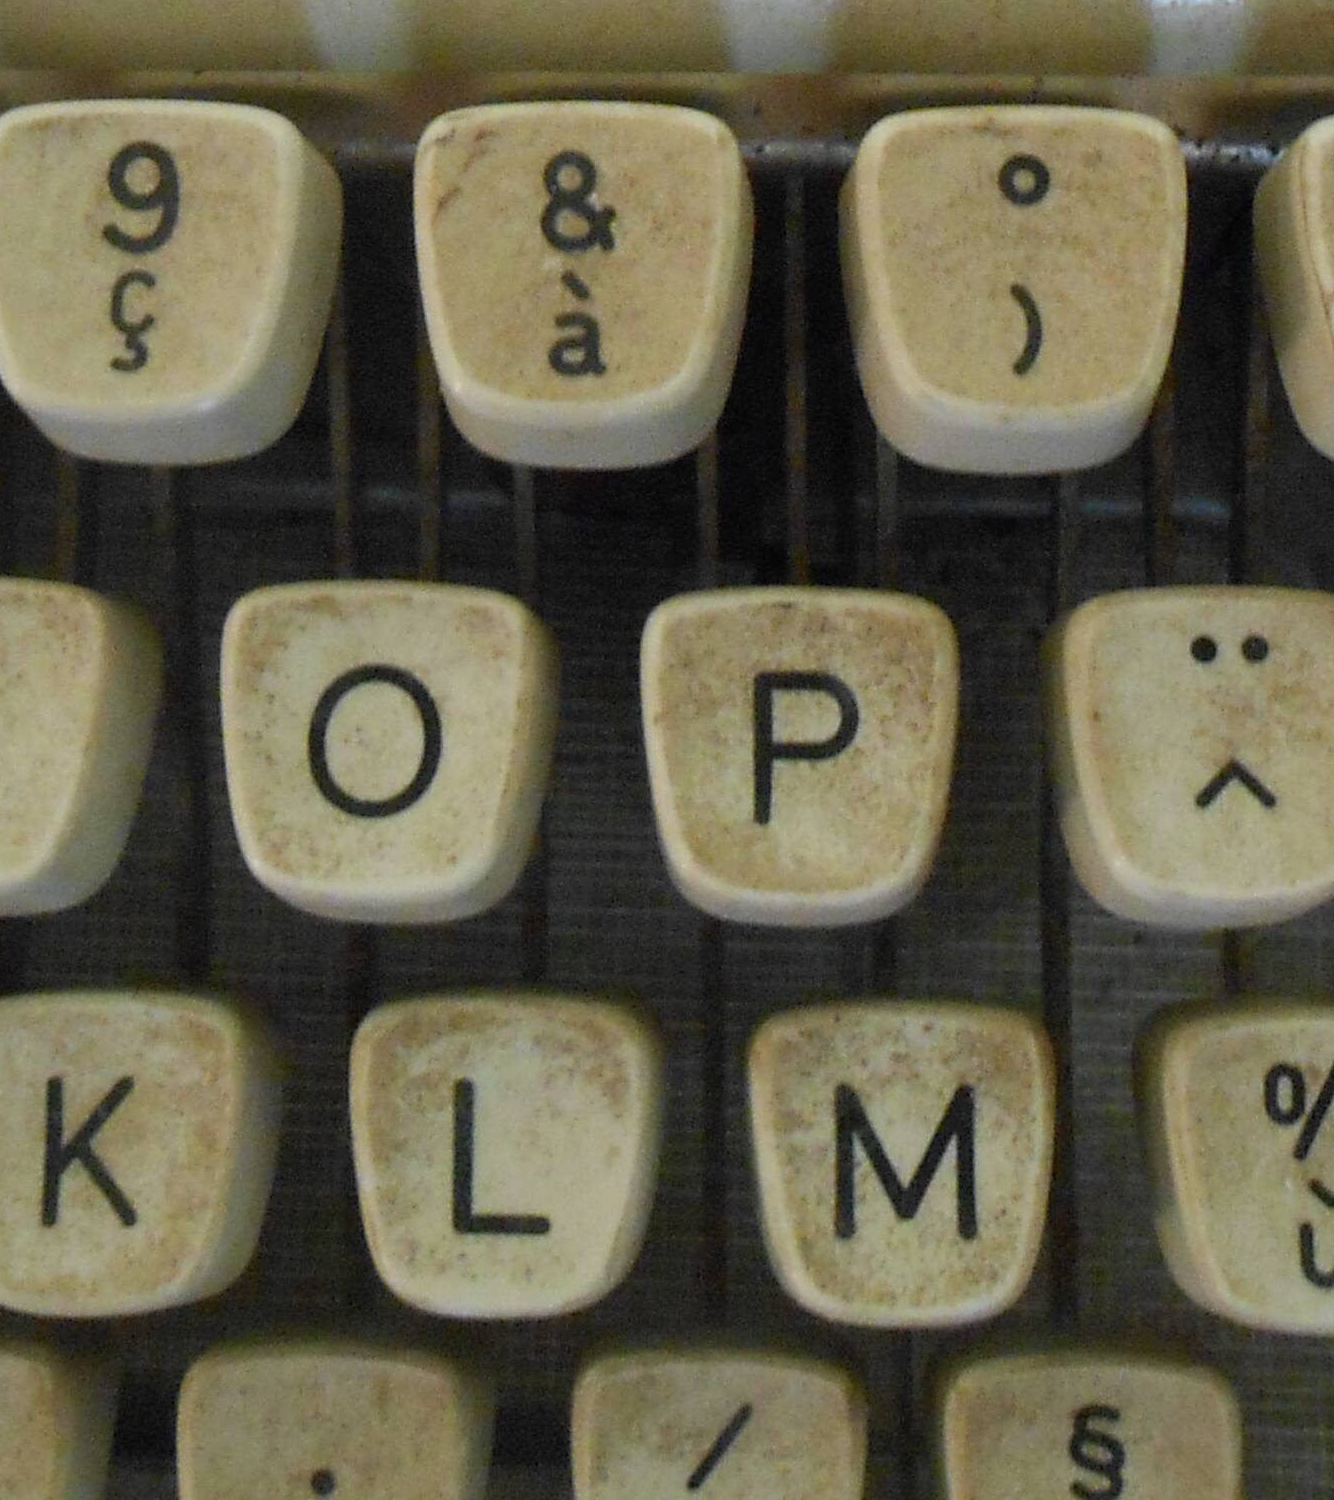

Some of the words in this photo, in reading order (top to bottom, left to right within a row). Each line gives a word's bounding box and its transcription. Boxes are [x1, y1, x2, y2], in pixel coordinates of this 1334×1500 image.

[102, 142, 180, 255] 9
[540, 151, 616, 254] &
[110, 270, 156, 372] ç
[548, 271, 606, 377] à
[1010, 284, 1043, 376] )
[308, 664, 442, 819] O
[752, 670, 859, 825] P
[41, 1077, 136, 1227] K
[452, 1079, 550, 1236] L
[834, 1083, 977, 1241] M
